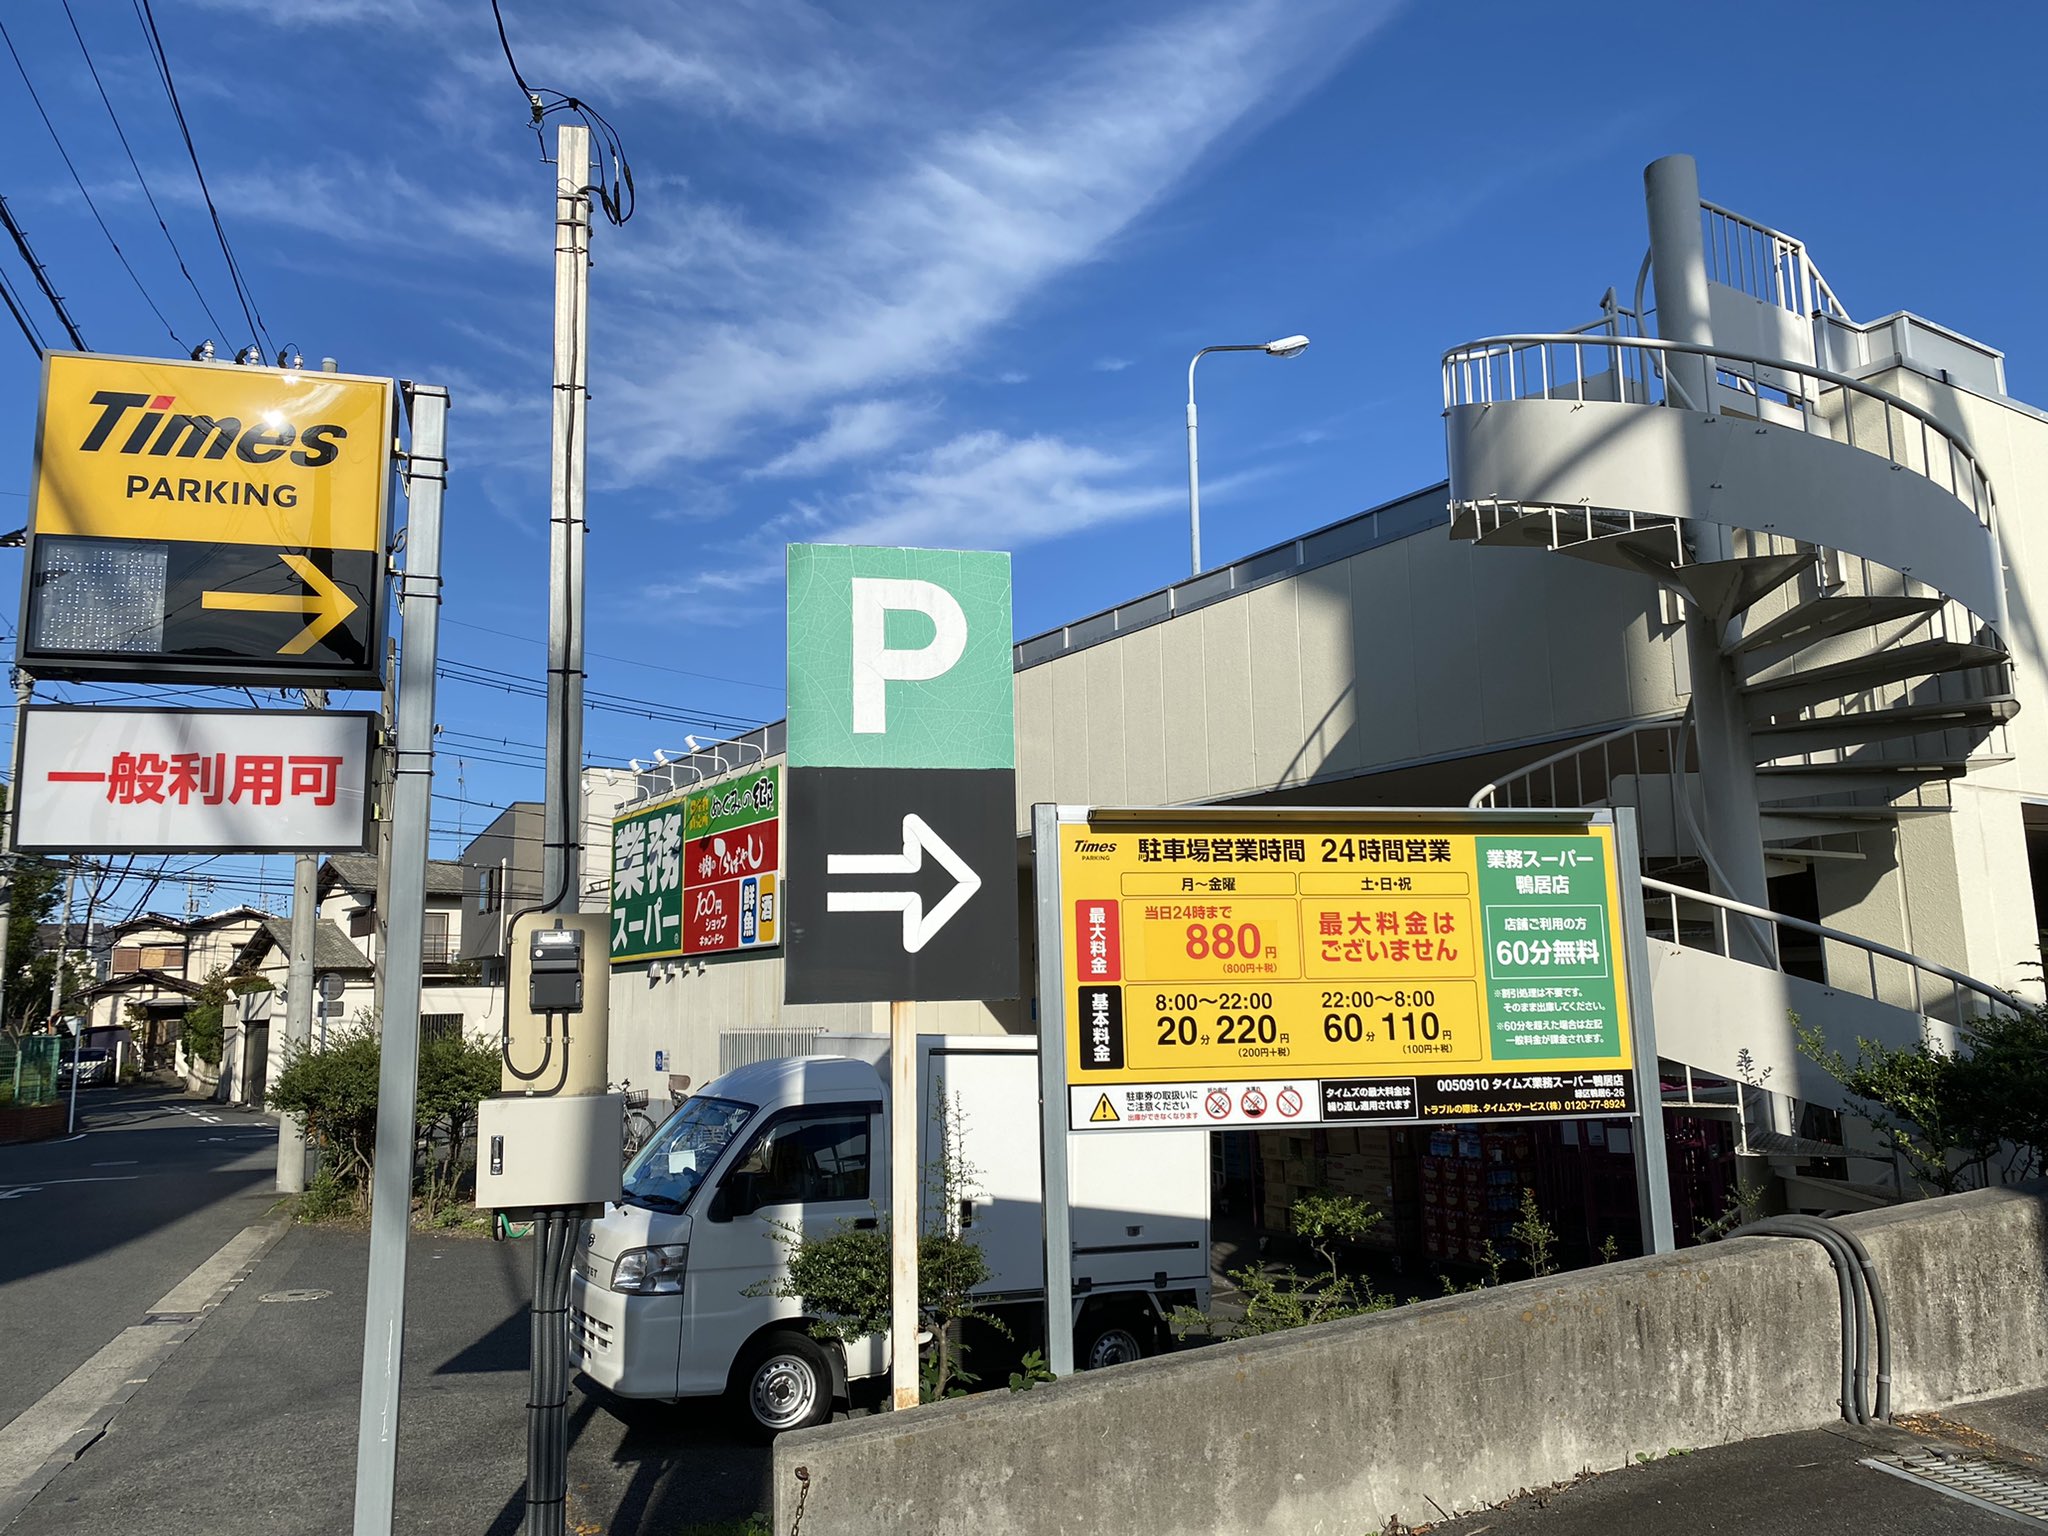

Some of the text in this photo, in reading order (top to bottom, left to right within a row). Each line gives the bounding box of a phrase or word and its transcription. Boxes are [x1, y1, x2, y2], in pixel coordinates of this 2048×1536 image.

[79, 391, 347, 467] Times
[126, 475, 297, 507] PARKING
[852, 577, 967, 733] P
[47, 752, 343, 807] 一般利用可
[614, 813, 682, 901] 業務
[1073, 840, 1117, 853] Times
[1138, 838, 1451, 863] 駐車場営業時間 24時間営業
[1486, 849, 1594, 869] 業務スーパー
[1361, 877, 1412, 891] 土・日・祝
[1515, 875, 1570, 894] 鴨居店
[743, 884, 756, 938] 鮮魚
[760, 893, 773, 922] 酒
[1144, 906, 1232, 920] 当日24時まで
[612, 897, 679, 952] スーパー
[705, 915, 728, 932] ショップ
[1319, 911, 1455, 936] 最大料金は
[1504, 917, 1587, 931] 店舗ご利用の方
[1089, 907, 1108, 975] 最大料金
[1185, 923, 1277, 960] 880円
[1321, 938, 1458, 962] ございません
[1496, 939, 1599, 966] 60分無料
[1155, 993, 1273, 1011] 8:00〜22:00
[1321, 990, 1435, 1008] 22:00〜8:00
[1091, 993, 1111, 1062] 基本料金
[1126, 1090, 1198, 1101] 駐車券の取扱いに
[1326, 1086, 1411, 1098] タイムズの最大料金は
[1437, 1078, 1489, 1092] 0050910
[1126, 1101, 1190, 1112] ご注意ください
[1565, 1099, 1626, 1110] 0120-77-8924
